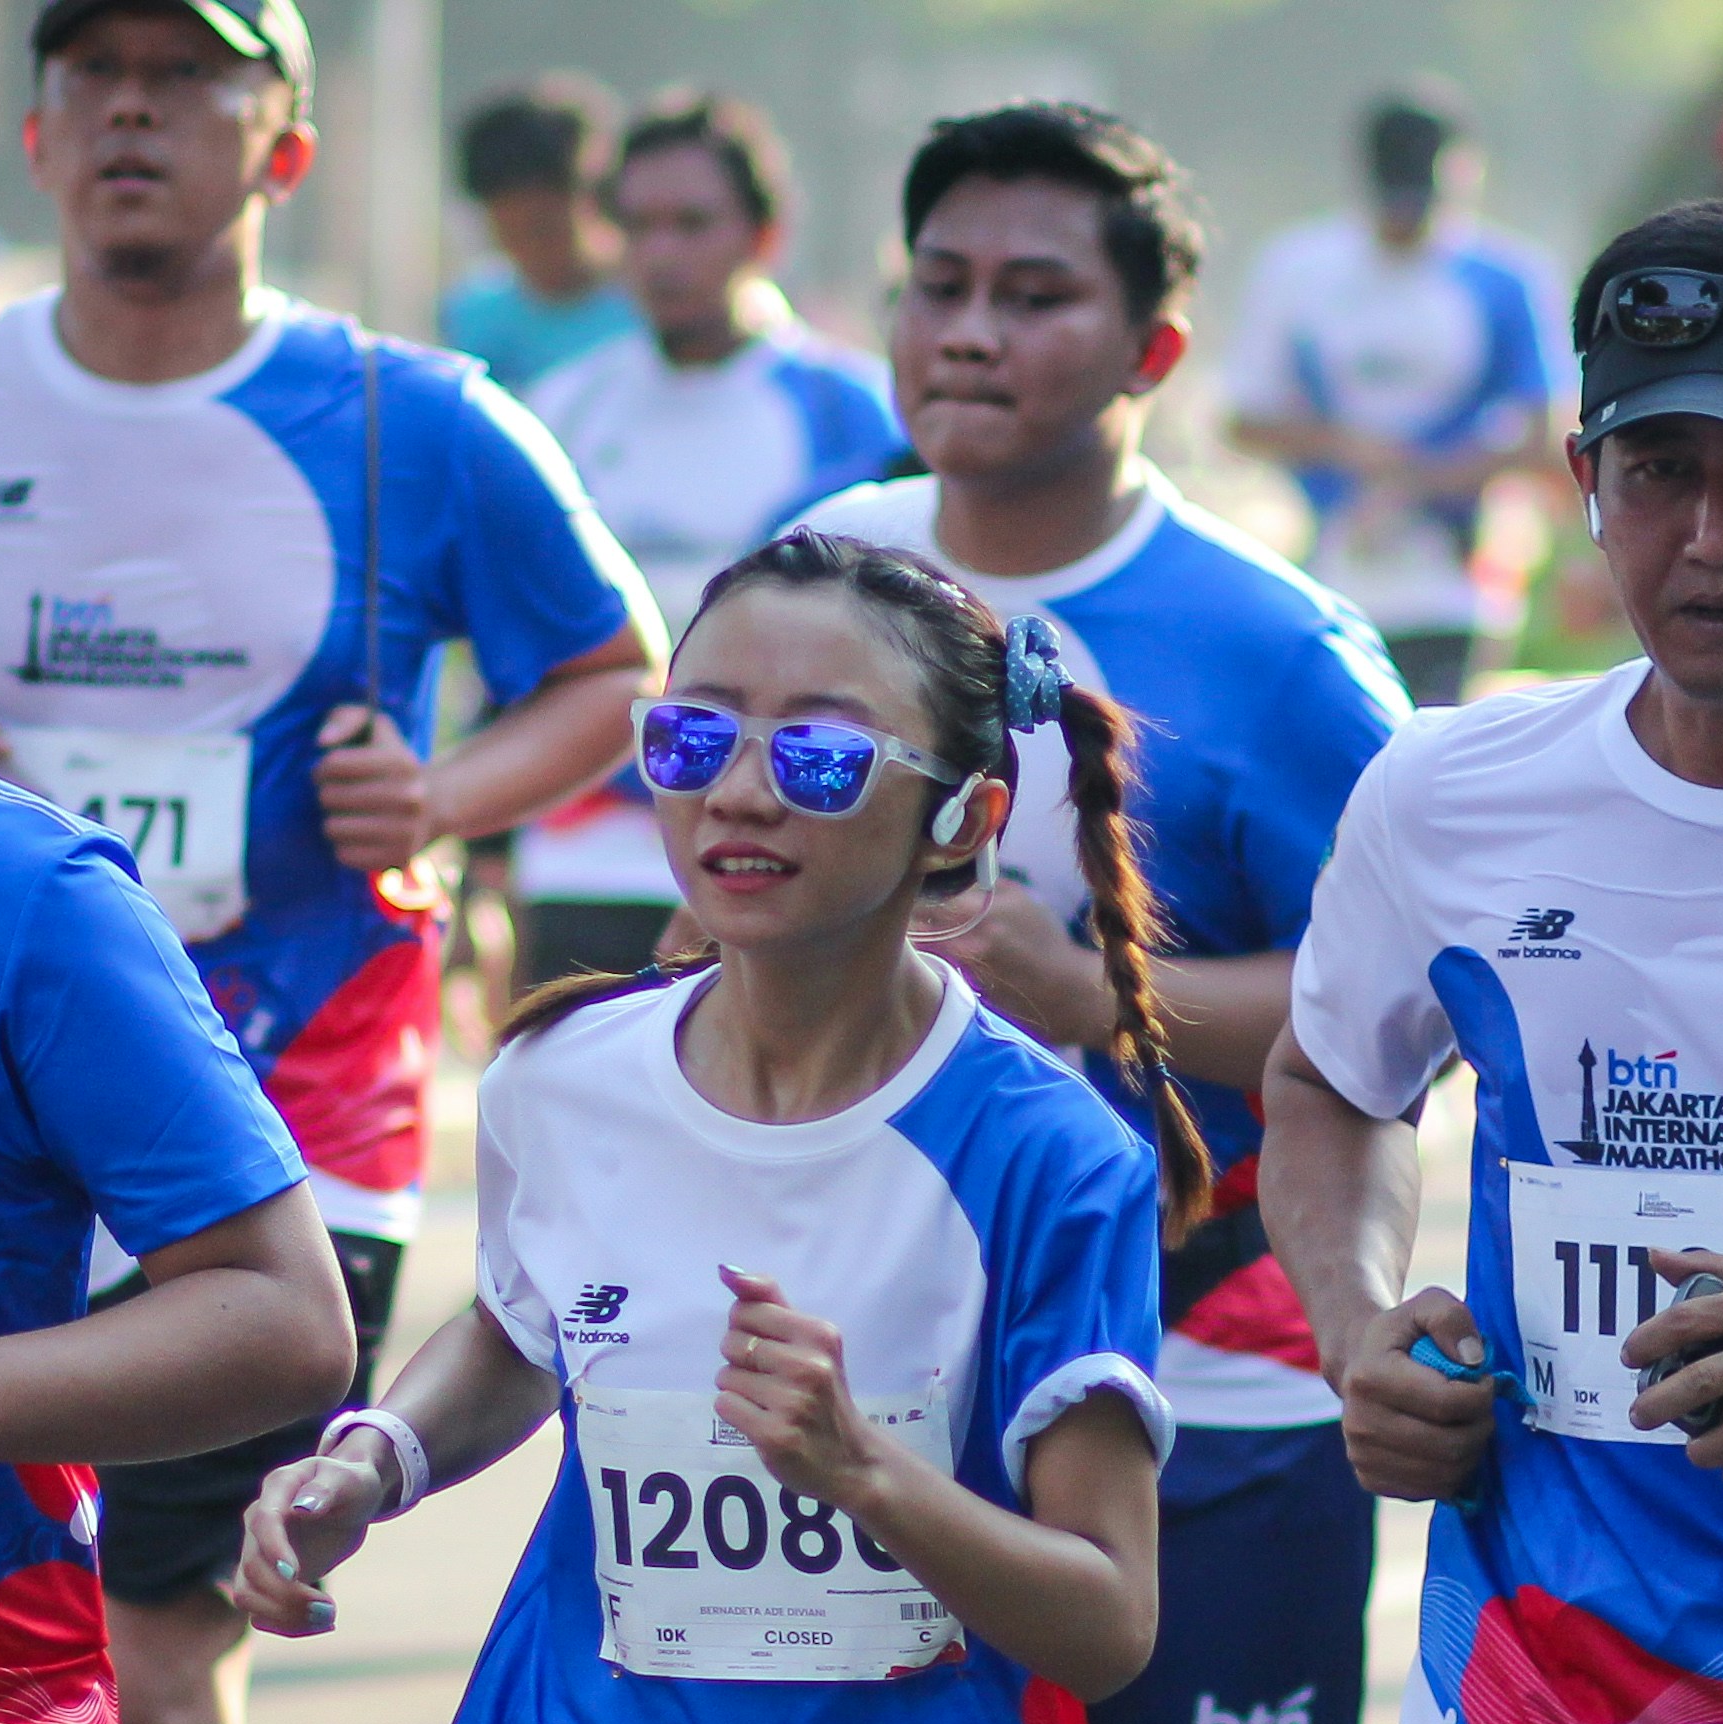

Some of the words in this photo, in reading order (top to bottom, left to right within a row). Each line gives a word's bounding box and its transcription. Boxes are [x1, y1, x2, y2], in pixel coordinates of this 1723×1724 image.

[79, 796, 188, 868] 71
[1523, 945, 1582, 960] balance
[1533, 1356, 1555, 1397] M
[1573, 1390, 1601, 1404] 10K
[608, 1593, 621, 1630] F
[699, 1606, 762, 1617] BERNADETA
[764, 1607, 784, 1617] ADE
[655, 1628, 687, 1642] 10K
[764, 1630, 834, 1645] CLOSED
[919, 1631, 932, 1643] C
